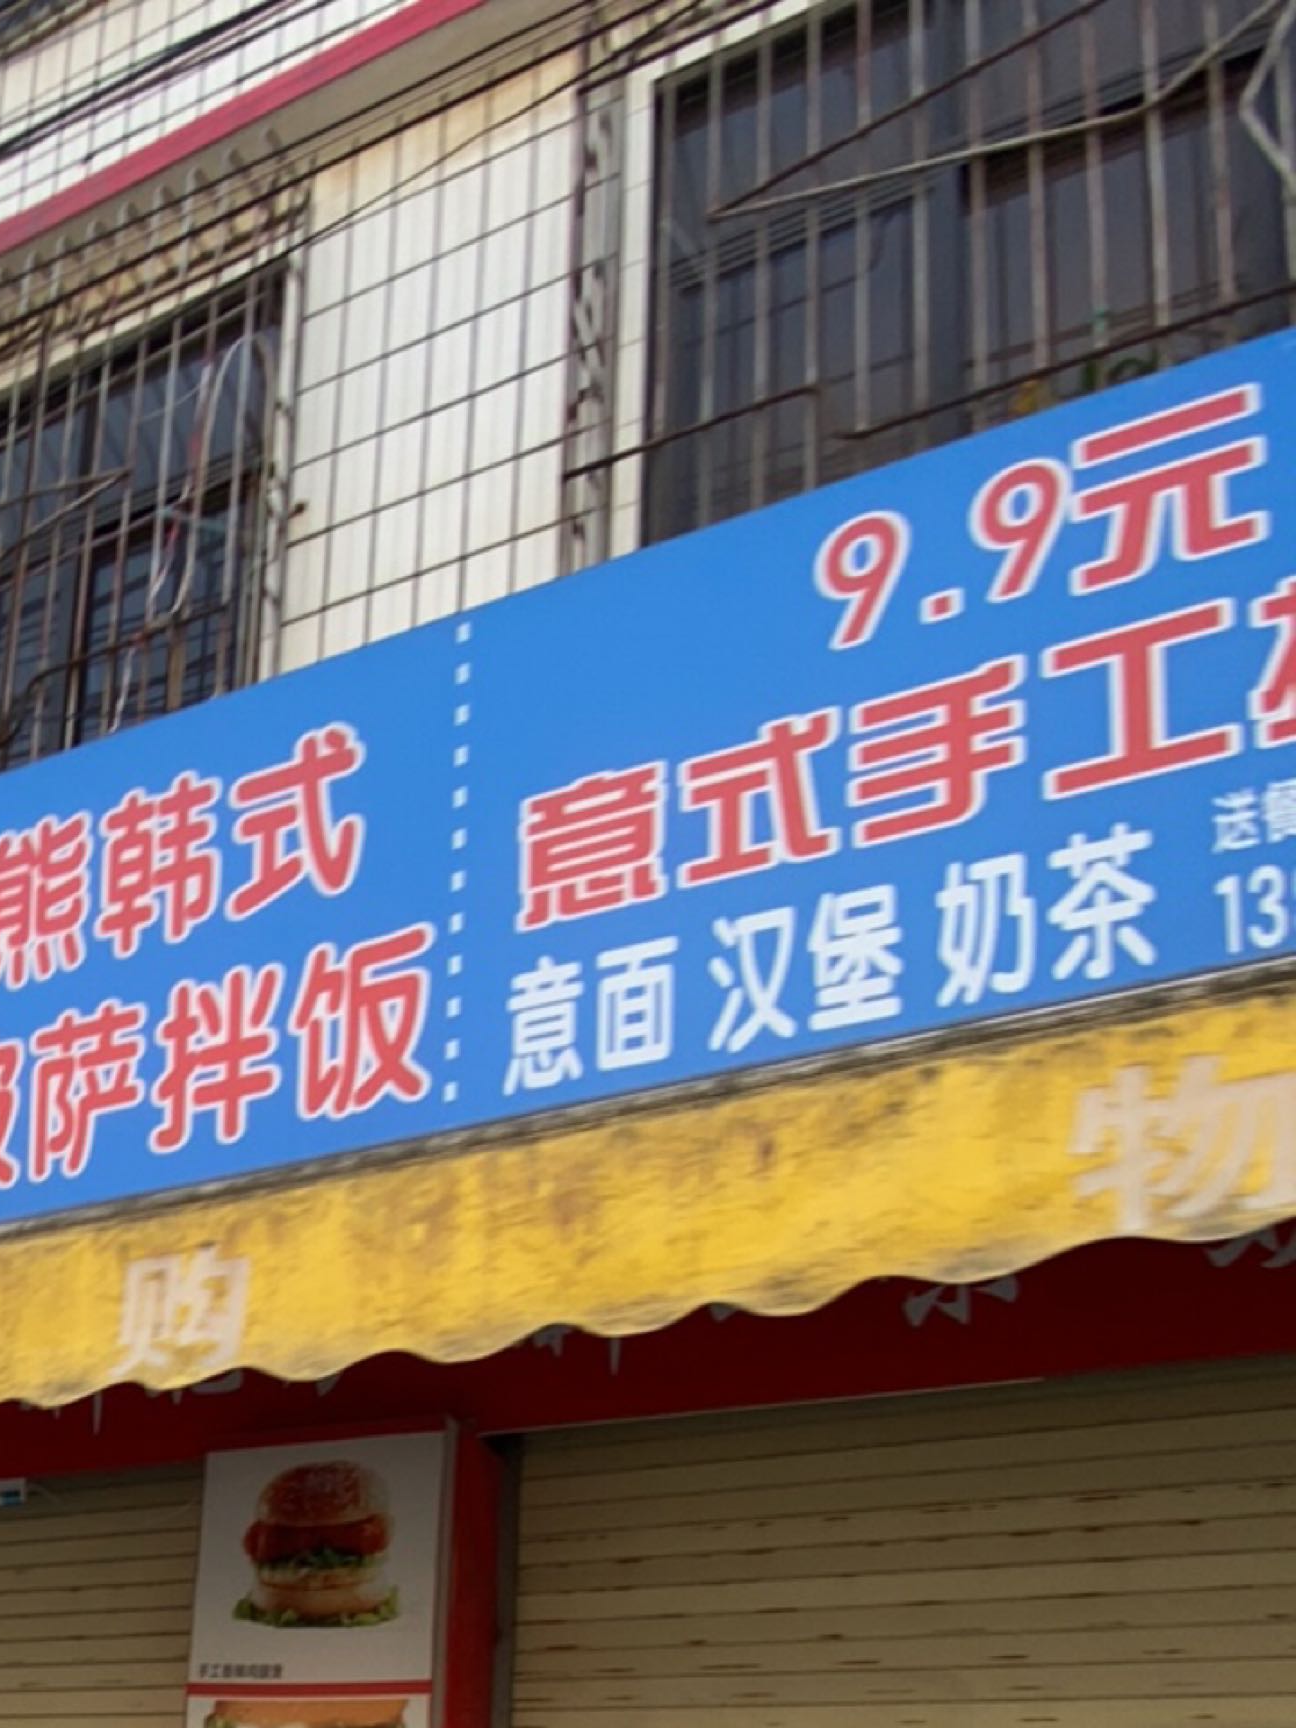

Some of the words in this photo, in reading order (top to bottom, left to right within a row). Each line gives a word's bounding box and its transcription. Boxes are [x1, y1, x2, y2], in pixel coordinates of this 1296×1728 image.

[815, 382, 1270, 650] 9.9元
[503, 935, 680, 1096] 意面
[707, 885, 903, 1055] 汉堡
[935, 826, 1157, 1007] 奶茶
[1213, 862, 1296, 956] 13
